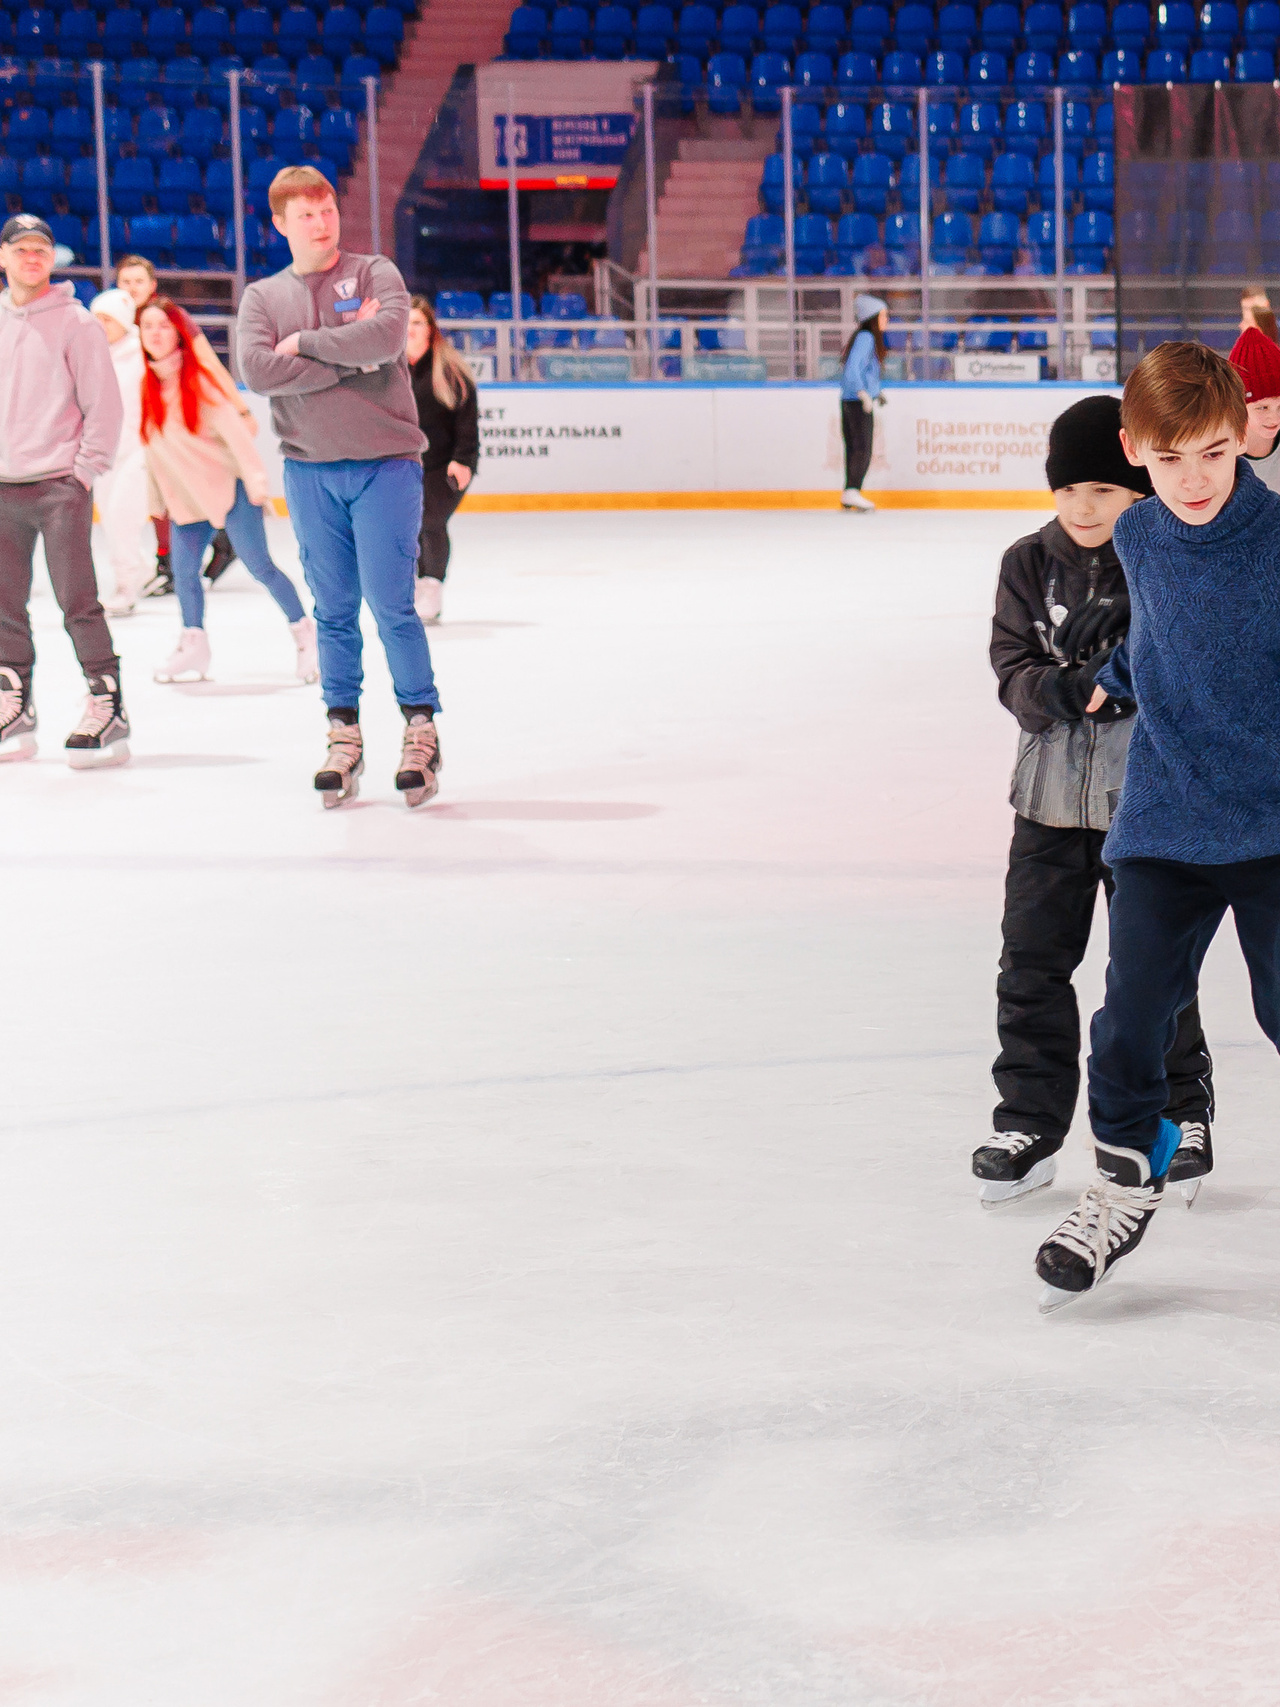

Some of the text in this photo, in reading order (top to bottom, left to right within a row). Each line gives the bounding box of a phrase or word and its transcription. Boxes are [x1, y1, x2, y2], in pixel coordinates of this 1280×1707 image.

[478, 408, 505, 420] ЕТ
[480, 444, 549, 458] ЕЙНАЯ
[915, 438, 1051, 458] Нижегородс
[915, 457, 1000, 475] области
